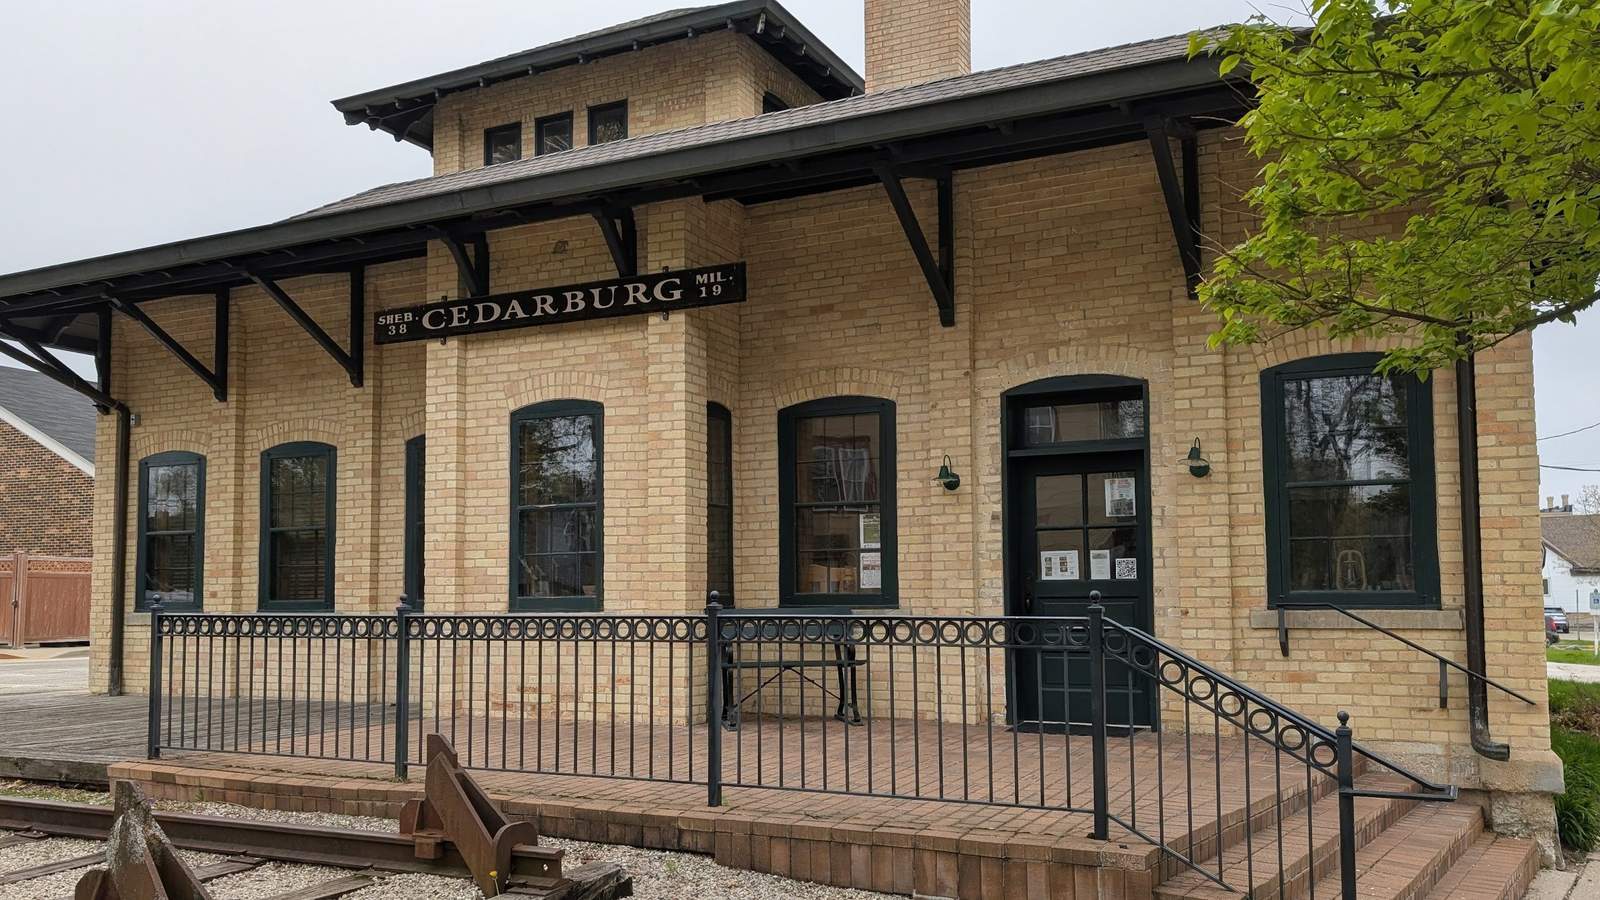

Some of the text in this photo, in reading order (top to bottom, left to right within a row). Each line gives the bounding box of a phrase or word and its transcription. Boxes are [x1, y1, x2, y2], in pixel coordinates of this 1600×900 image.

[699, 284, 722, 298] 19
[421, 278, 685, 330] CEDARBURG
[388, 323, 407, 335] 38
